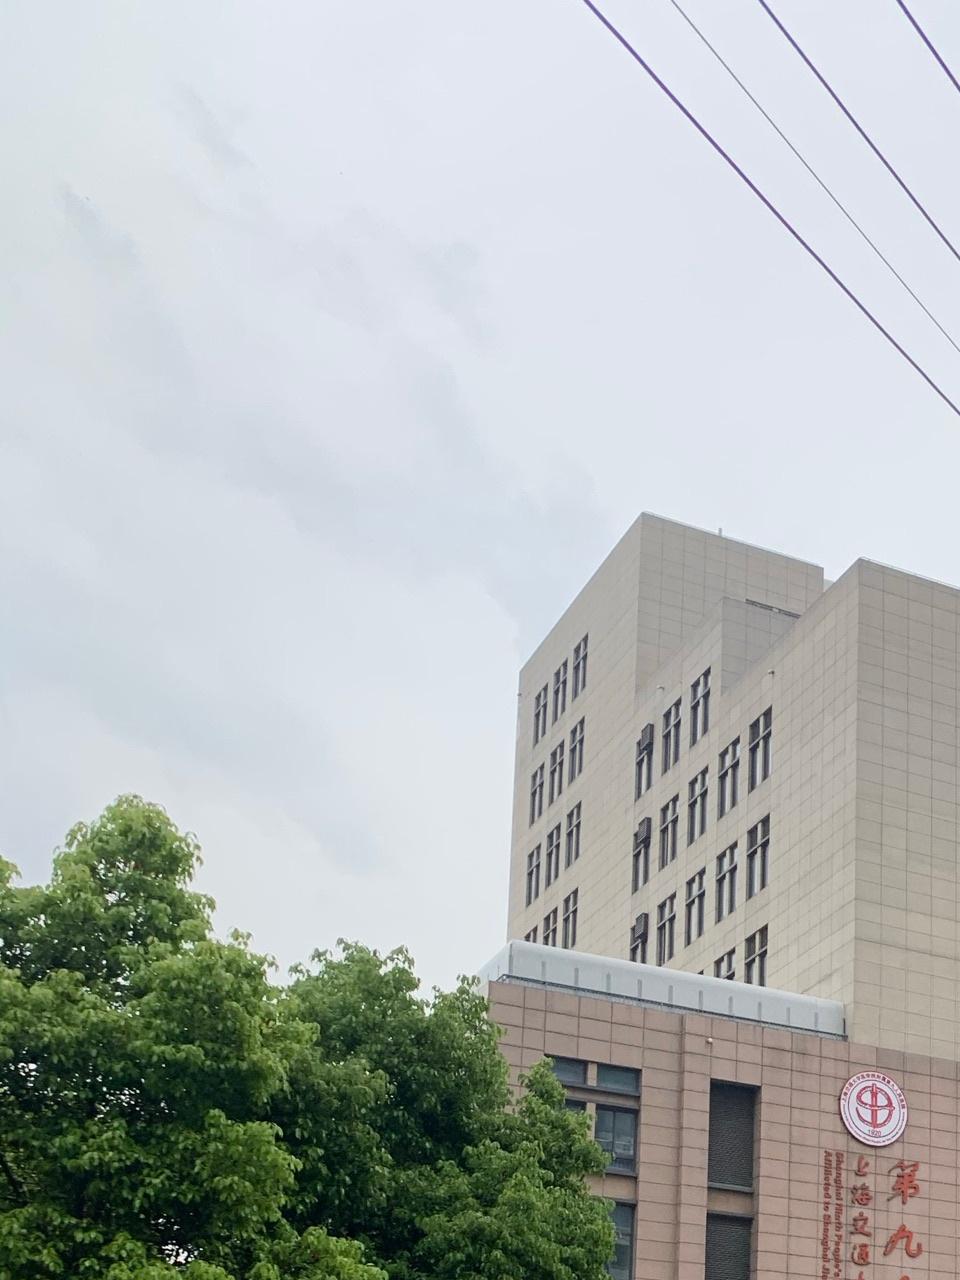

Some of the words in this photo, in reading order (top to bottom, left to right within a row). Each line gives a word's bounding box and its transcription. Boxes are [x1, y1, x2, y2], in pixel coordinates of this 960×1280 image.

[823, 1150, 833, 1199] Affiliated
[834, 1151, 845, 1200] Shanghai
[820, 1214, 832, 1262] Shanghai
[834, 1203, 844, 1231] Ninth
[832, 1234, 843, 1278] People's
